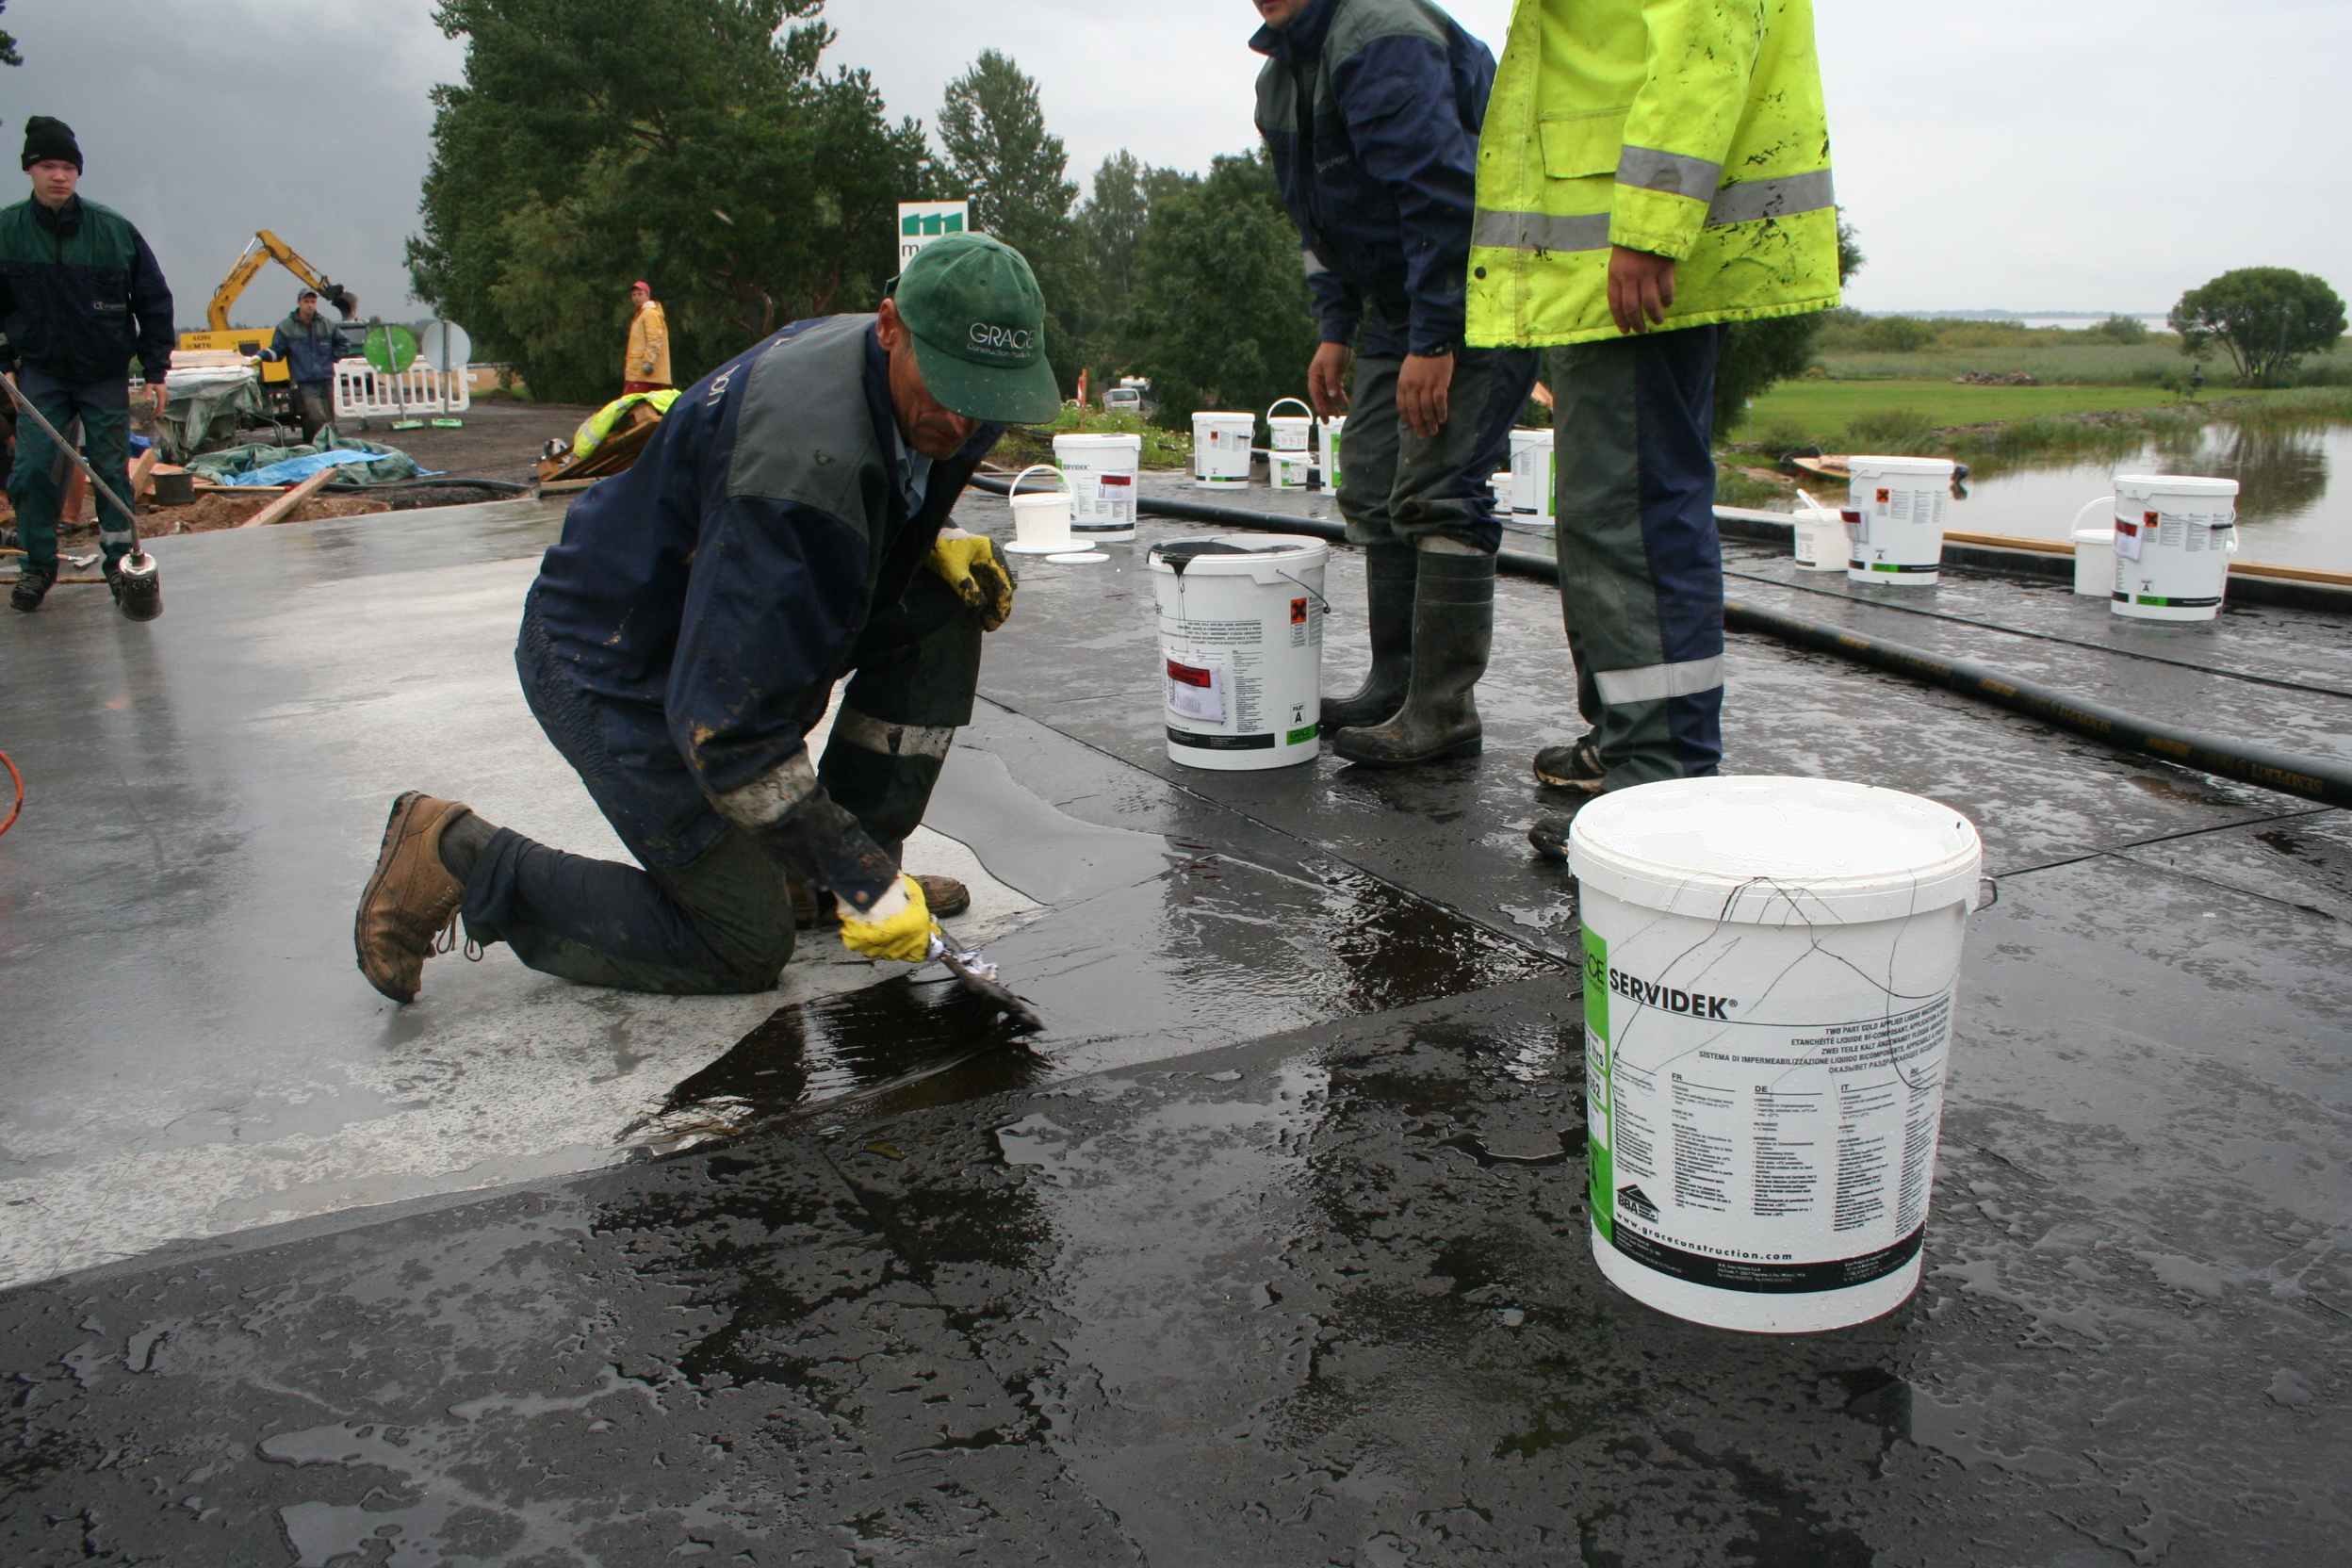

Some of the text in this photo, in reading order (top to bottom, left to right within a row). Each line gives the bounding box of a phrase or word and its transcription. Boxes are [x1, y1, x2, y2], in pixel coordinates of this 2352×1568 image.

[970, 322, 1035, 349] GRACE
[1295, 711, 1303, 723] A
[1842, 1025, 1859, 1034] PART
[1837, 1035, 1862, 1044] LIQUIDE
[1840, 1045, 1859, 1054] TEILE
[1860, 1043, 1875, 1052] KALT
[1699, 1051, 1730, 1062] SISTEMA
[1741, 1056, 1829, 1065] IMPERMEABILIZZAZIONE
[1831, 1054, 1857, 1064] LIQUIDO
[1672, 1072, 1683, 1082] FR
[1841, 1084, 1851, 1092] IT
[1617, 1192, 1639, 1216] BBA
[1616, 1212, 1792, 1261] www.graceconstruction.com
